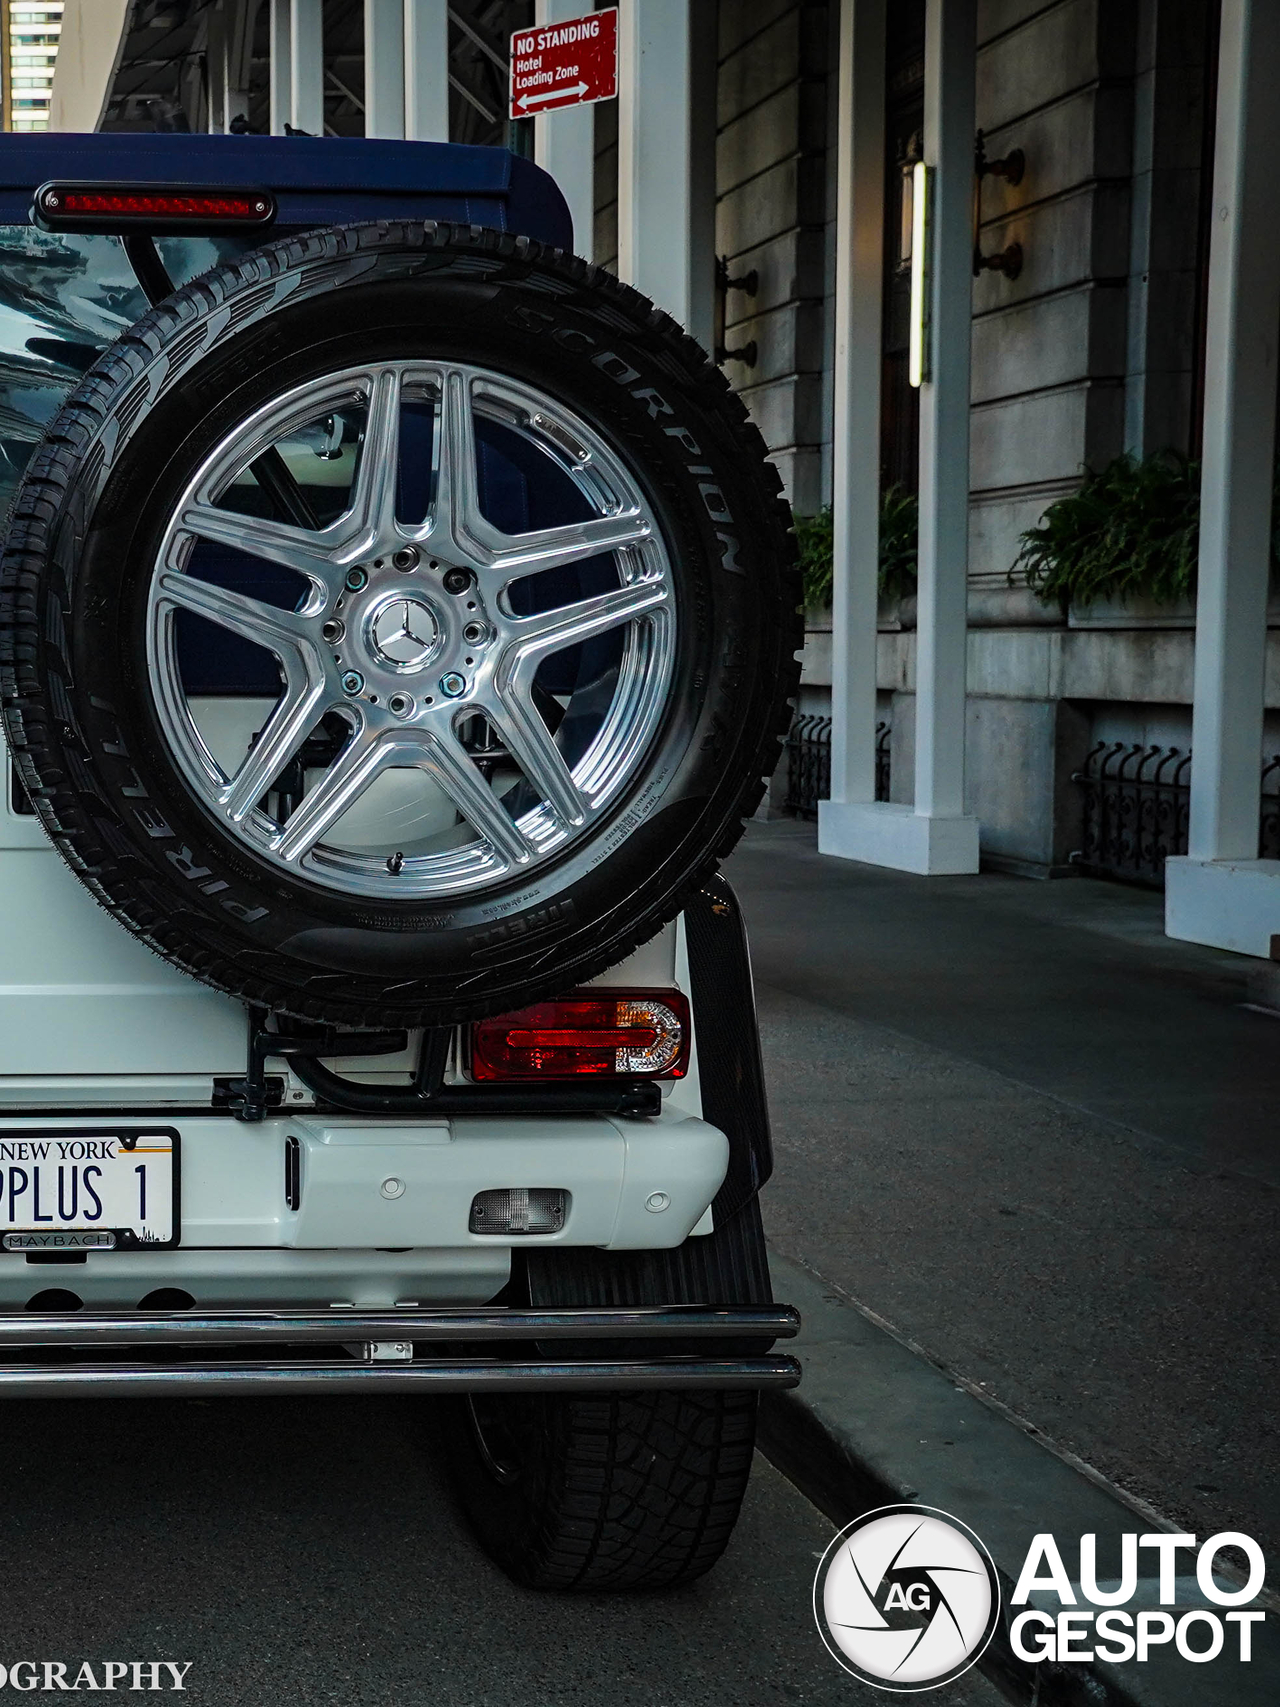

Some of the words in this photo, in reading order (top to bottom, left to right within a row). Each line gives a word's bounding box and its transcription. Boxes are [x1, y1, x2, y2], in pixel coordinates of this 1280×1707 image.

[516, 37, 535, 55] NO
[537, 21, 600, 51] STANDING
[516, 55, 542, 73] Hotel
[516, 71, 553, 89] Loading
[555, 65, 579, 80] Zone
[505, 304, 747, 577] SCORPION
[90, 695, 270, 923] PIRELLI
[0, 1142, 53, 1161] NEW
[56, 1141, 116, 1160] YORK
[134, 1164, 146, 1220] 1
[9, 1233, 110, 1247] MAYBACH
